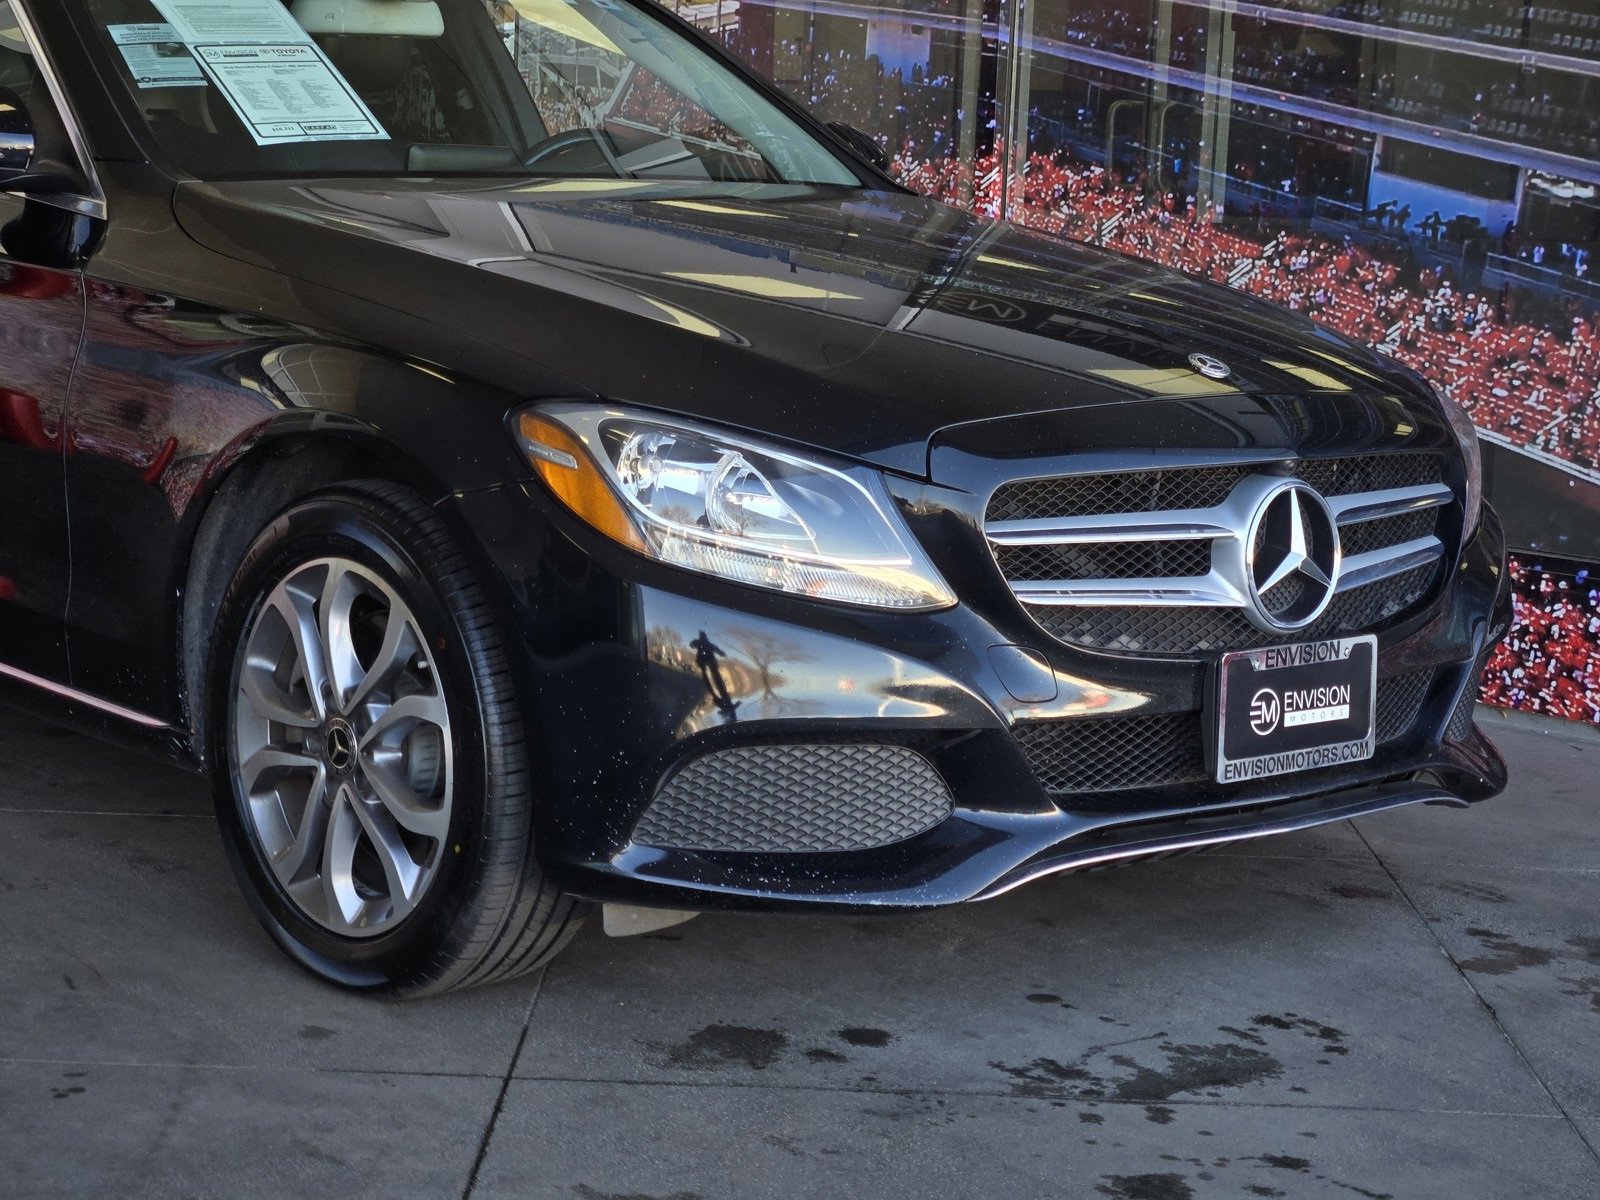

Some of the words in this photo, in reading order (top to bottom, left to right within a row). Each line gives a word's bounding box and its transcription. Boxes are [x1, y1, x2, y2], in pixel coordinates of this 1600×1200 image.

[1265, 641, 1340, 669] ENVISION
[1284, 684, 1350, 712] ENVISION
[1290, 710, 1344, 723] MOTORS
[1225, 741, 1369, 781] ENVISIONMOTORS.COM
